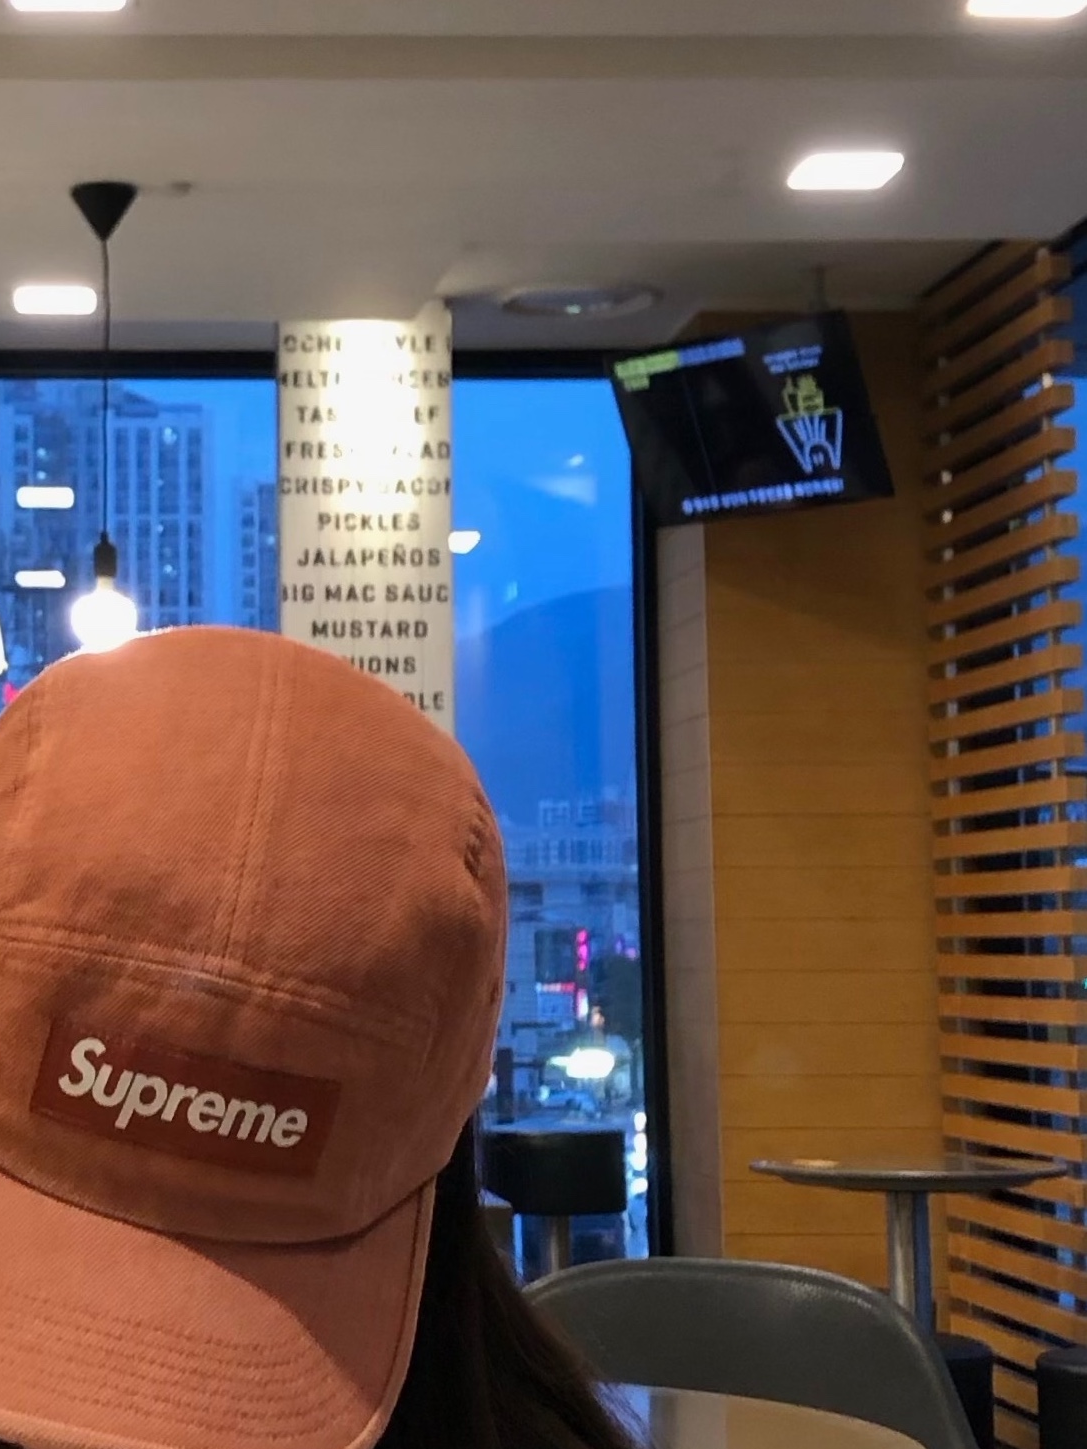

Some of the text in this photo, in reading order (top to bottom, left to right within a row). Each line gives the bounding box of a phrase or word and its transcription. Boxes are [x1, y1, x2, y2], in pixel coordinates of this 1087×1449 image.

[317, 512, 420, 531] PICKLES
[297, 543, 440, 567] JALAPEÑOS
[325, 584, 375, 603] MAC
[385, 584, 449, 603] SAUC
[311, 620, 429, 639] MUSTARD
[58, 1037, 308, 1147] Supreme
